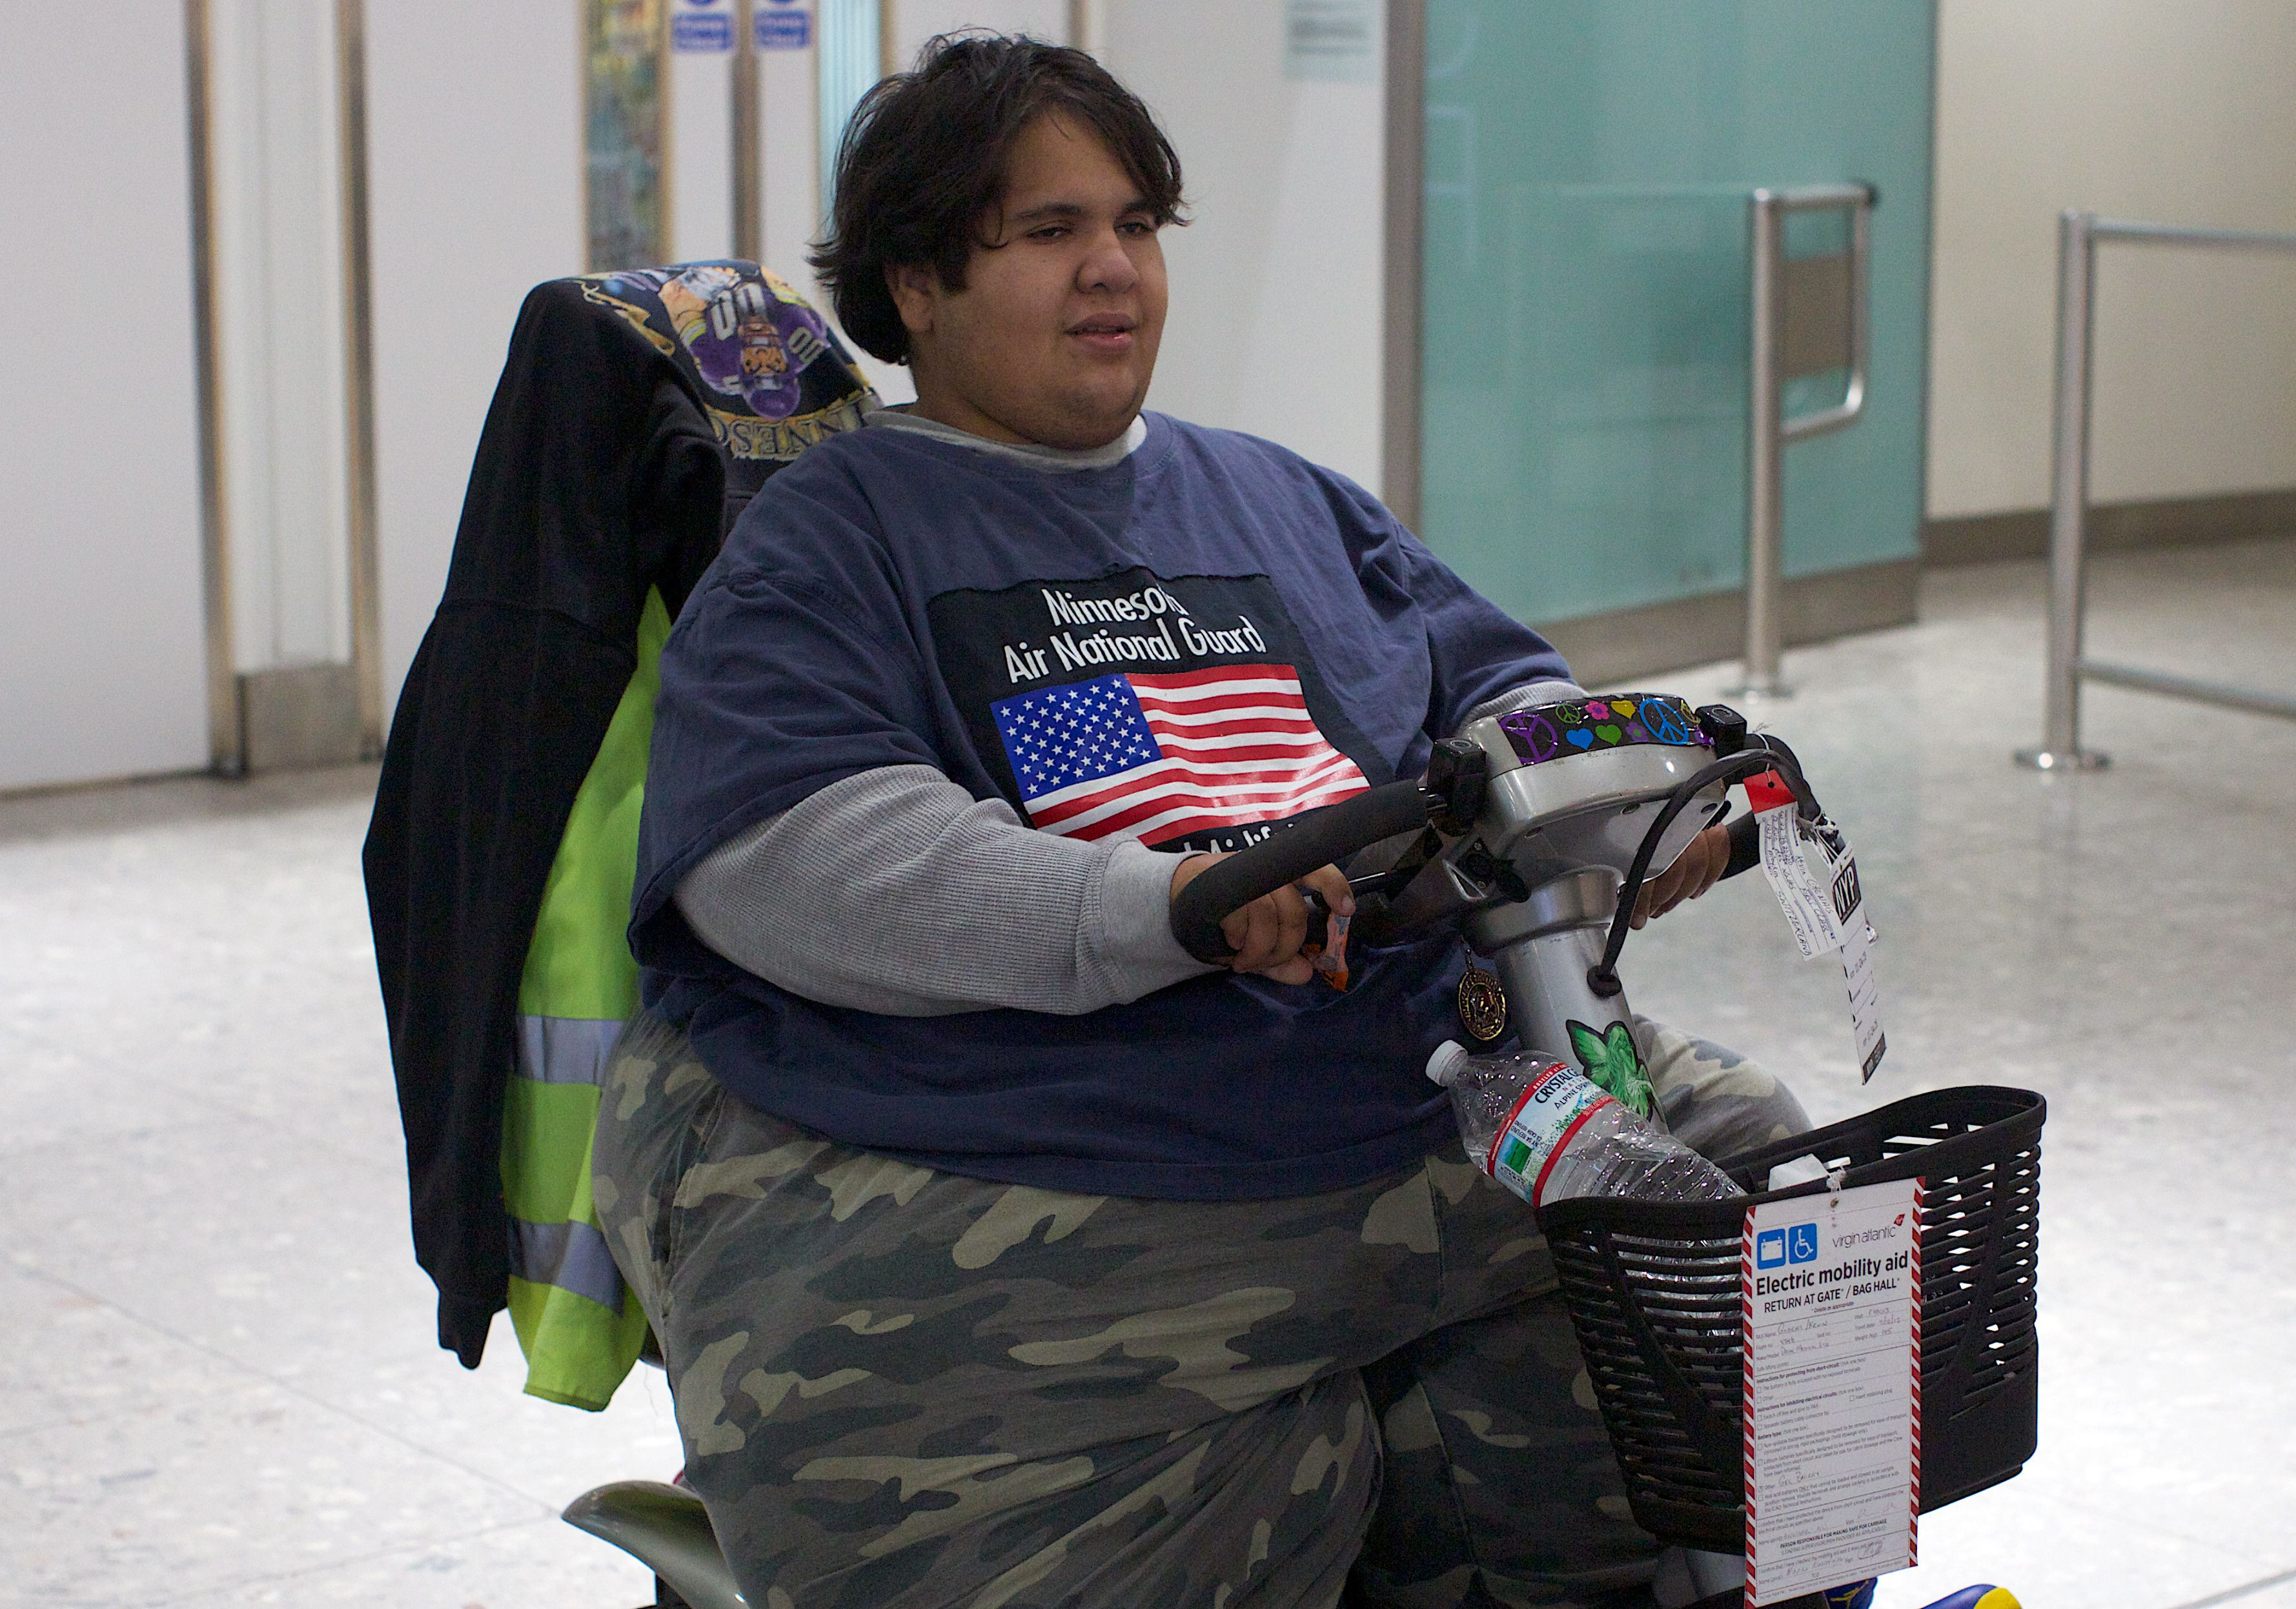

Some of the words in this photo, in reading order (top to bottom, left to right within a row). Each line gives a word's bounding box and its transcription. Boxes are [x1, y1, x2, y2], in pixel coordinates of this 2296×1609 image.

[1004, 643, 1049, 683] Air
[1051, 617, 1181, 672] National
[1177, 615, 1266, 656] Guard
[1534, 1071, 1573, 1104] CRYSTAL
[1554, 1088, 1576, 1110] ALPINE
[1756, 1268, 1814, 1296] Electric
[1818, 1256, 1881, 1286] mobility
[1885, 1250, 1908, 1271] aid
[1764, 1295, 1801, 1313] RETURN
[1803, 1293, 1814, 1305] AT
[1853, 1282, 1871, 1296] BAG
